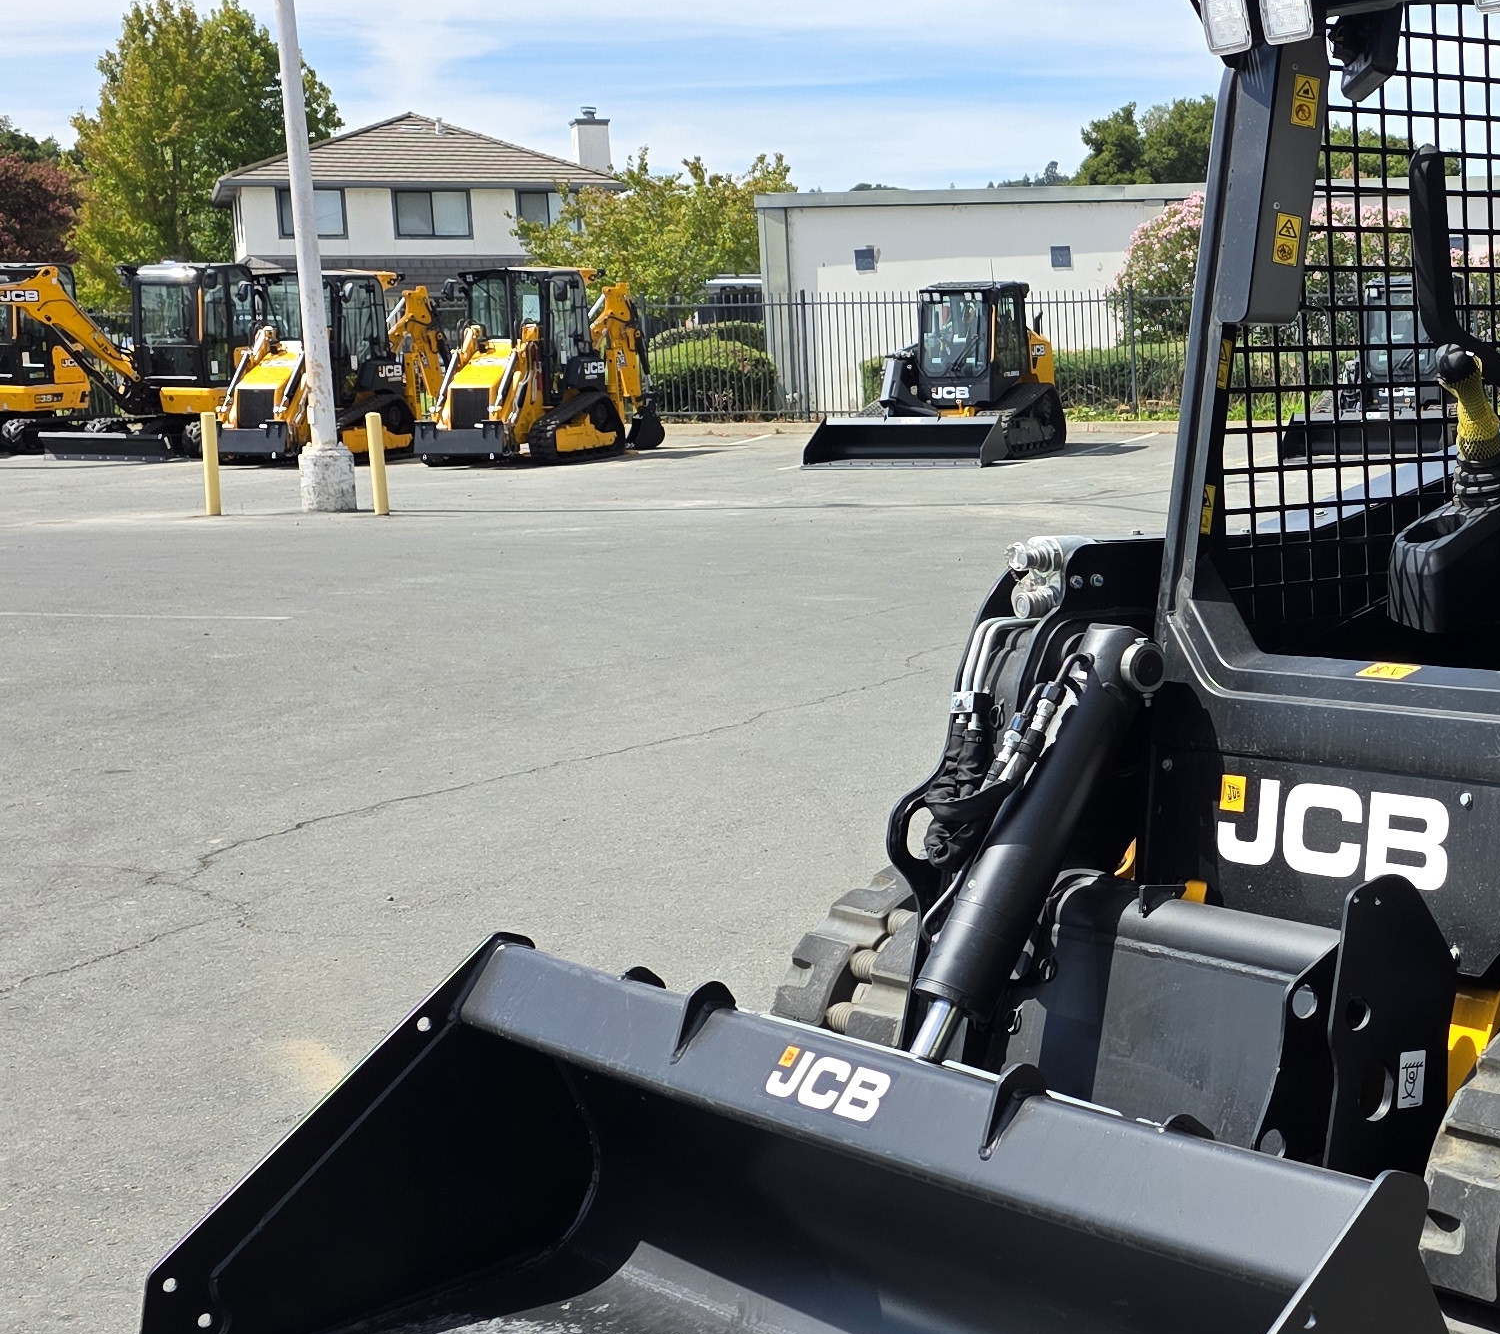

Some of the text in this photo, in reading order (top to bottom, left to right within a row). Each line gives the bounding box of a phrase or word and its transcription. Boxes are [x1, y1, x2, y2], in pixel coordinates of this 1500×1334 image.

[0, 291, 38, 302] JCB
[1032, 345, 1045, 356] JCB
[61, 359, 79, 367] JC
[584, 362, 605, 375] JCB
[378, 365, 402, 378] JCB
[932, 387, 970, 398] JCB
[1217, 778, 1450, 891] JCB
[765, 1050, 891, 1122] JCB
